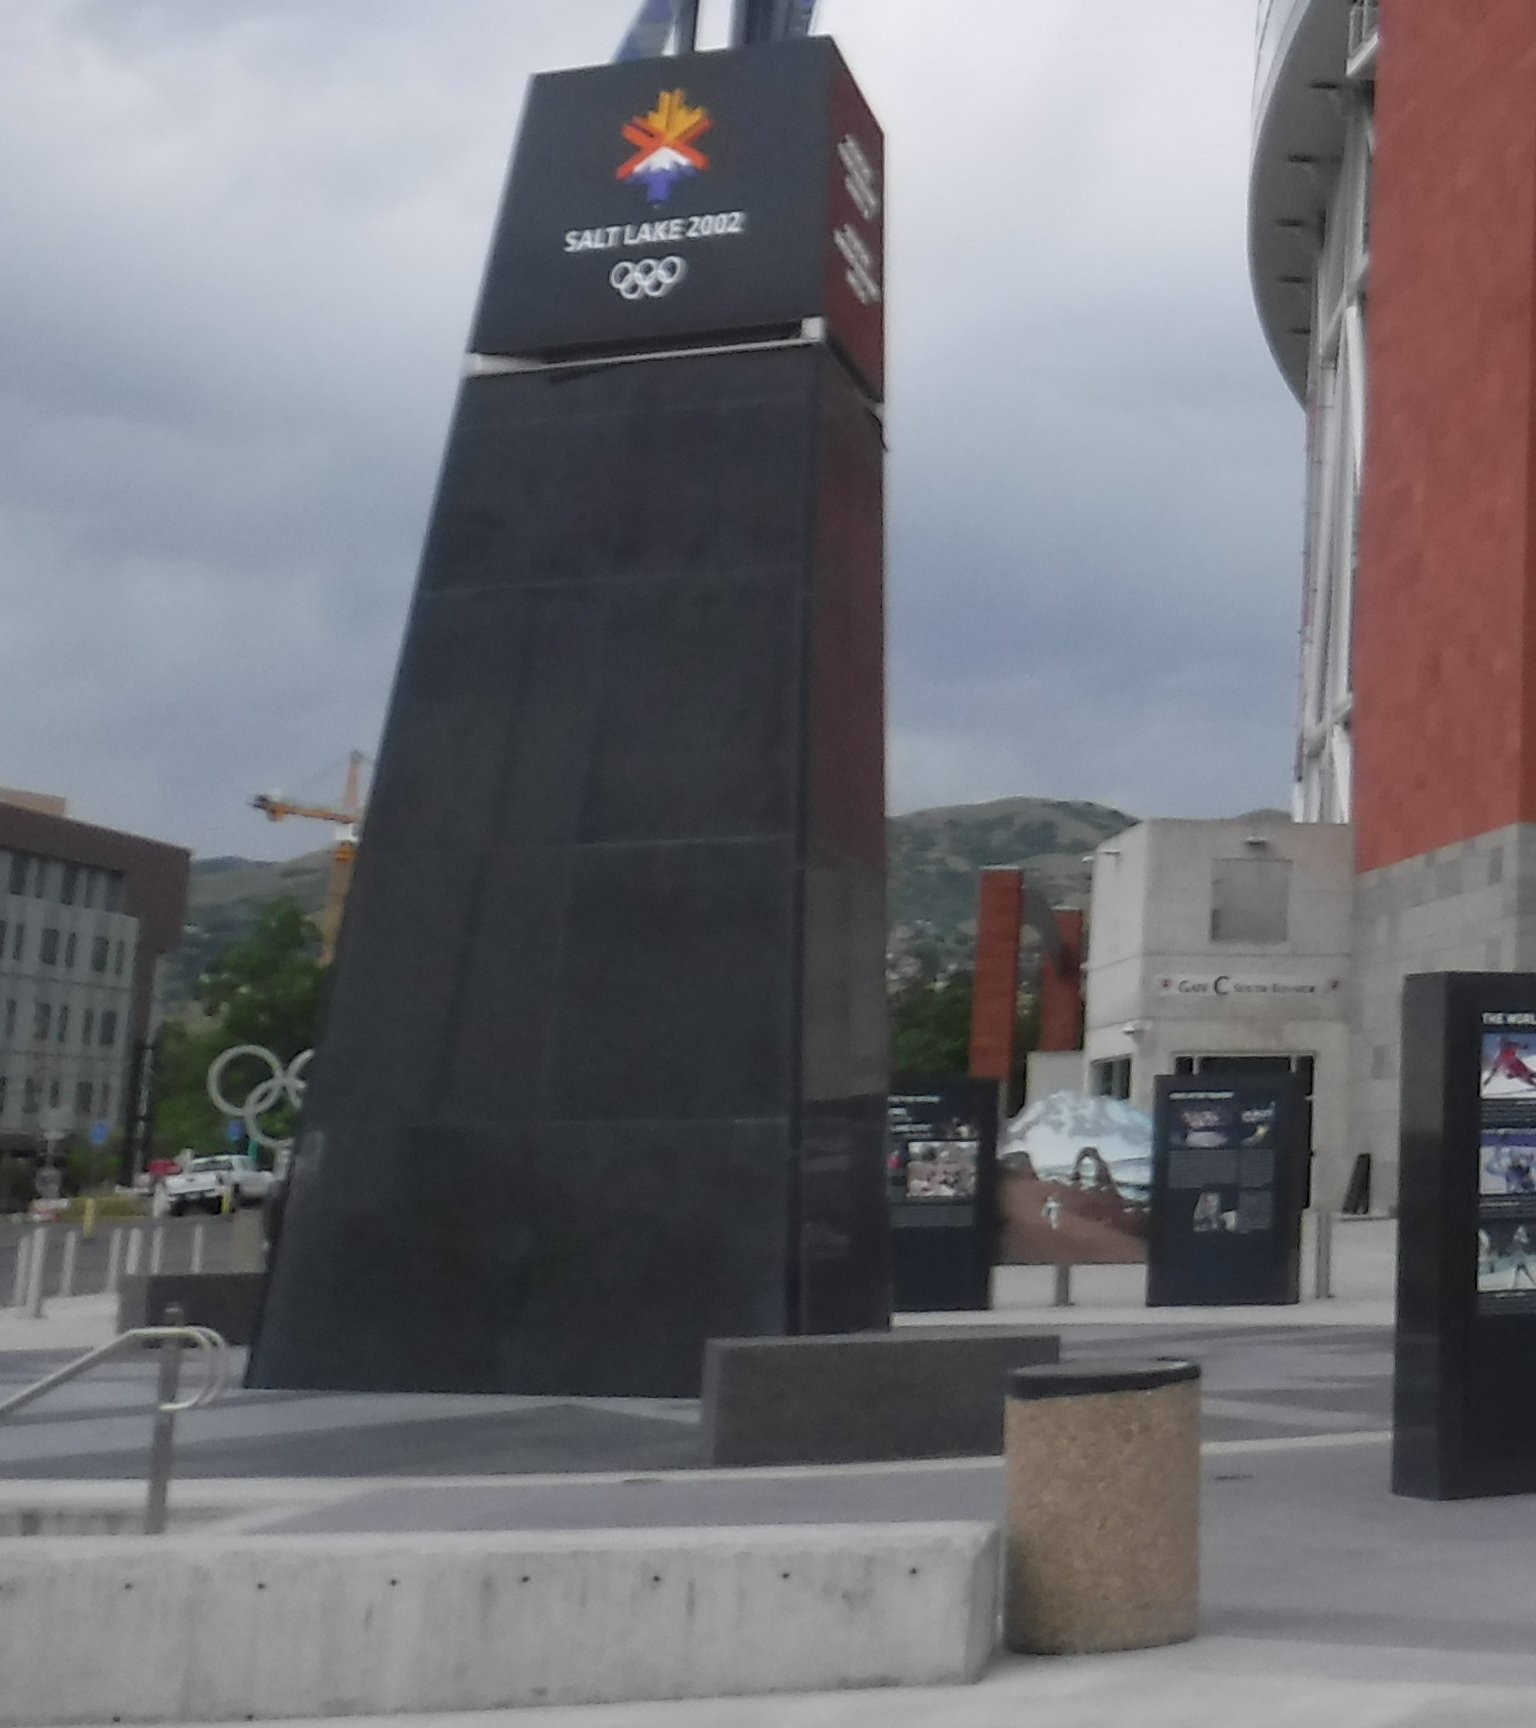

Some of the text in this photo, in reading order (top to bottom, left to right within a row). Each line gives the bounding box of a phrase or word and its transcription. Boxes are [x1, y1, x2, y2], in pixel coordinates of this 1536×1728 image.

[563, 210, 745, 253] SALT LAKE 2002
[1213, 975, 1230, 996] C
[1482, 1012, 1504, 1025] THE
